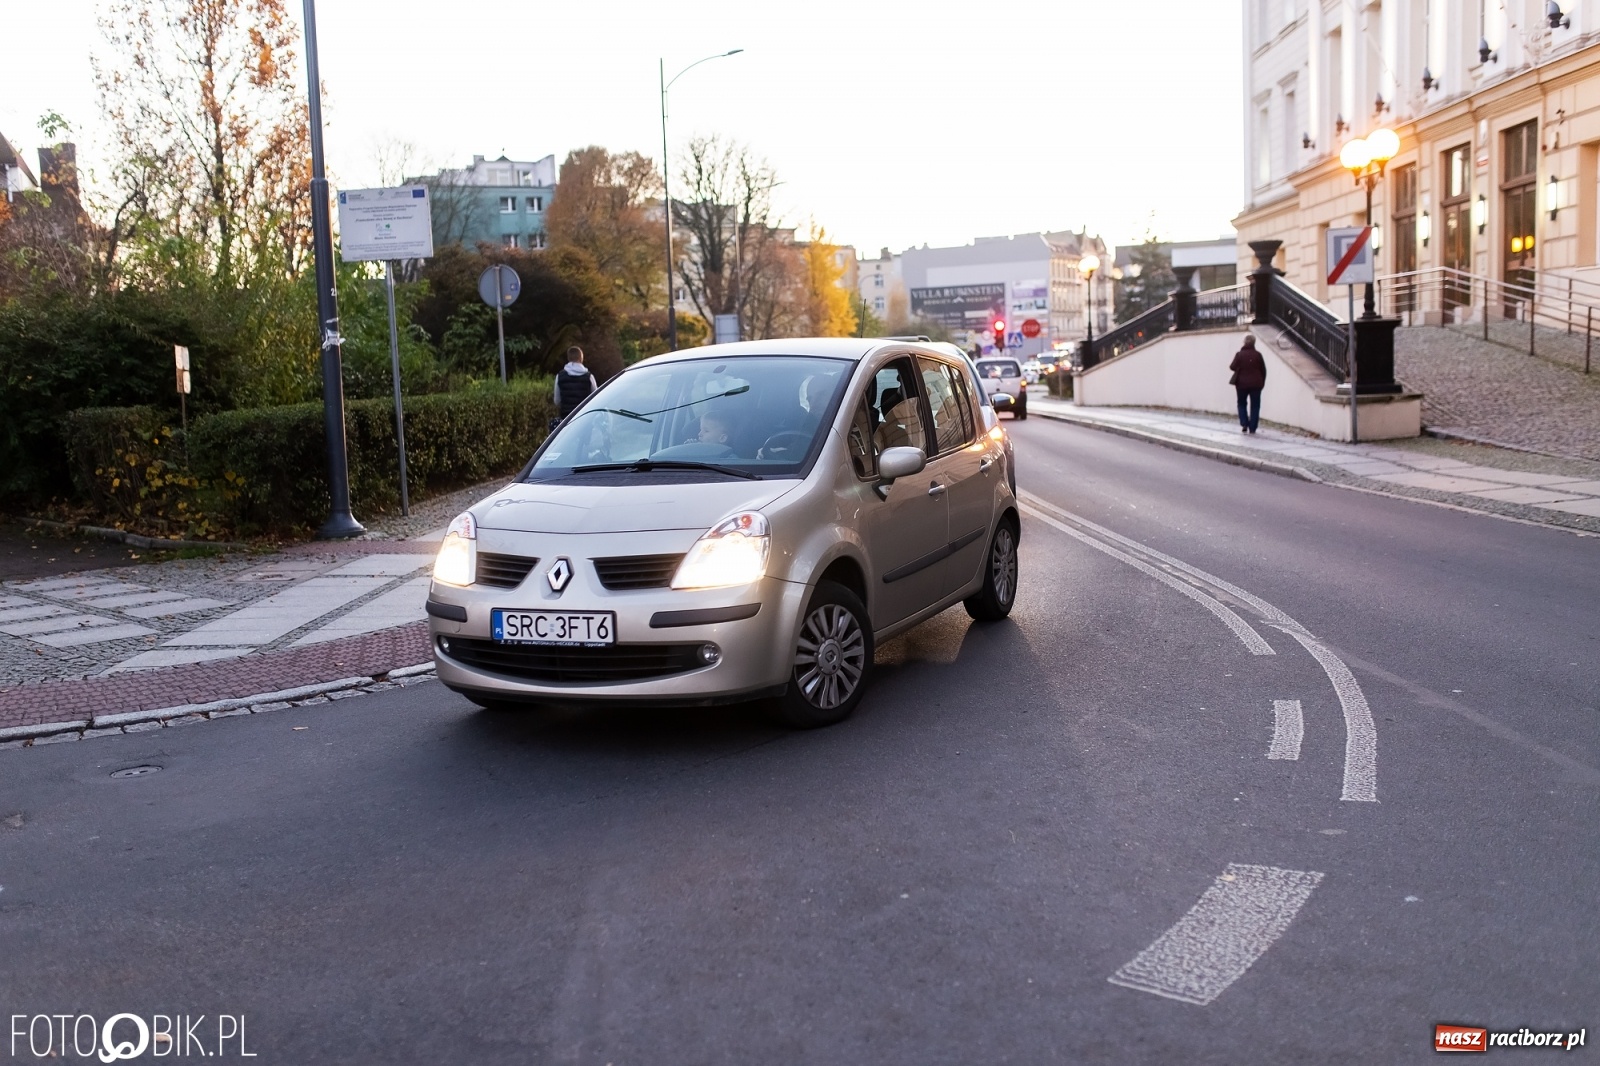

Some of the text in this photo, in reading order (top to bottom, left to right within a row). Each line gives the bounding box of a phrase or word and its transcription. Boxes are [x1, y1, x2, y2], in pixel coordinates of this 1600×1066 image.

[911, 285, 1004, 300] VILLA RUBINSTEIN
[1023, 324, 1040, 333] STOP
[495, 627, 503, 635] PL
[506, 614, 609, 640] SRC 3FT6
